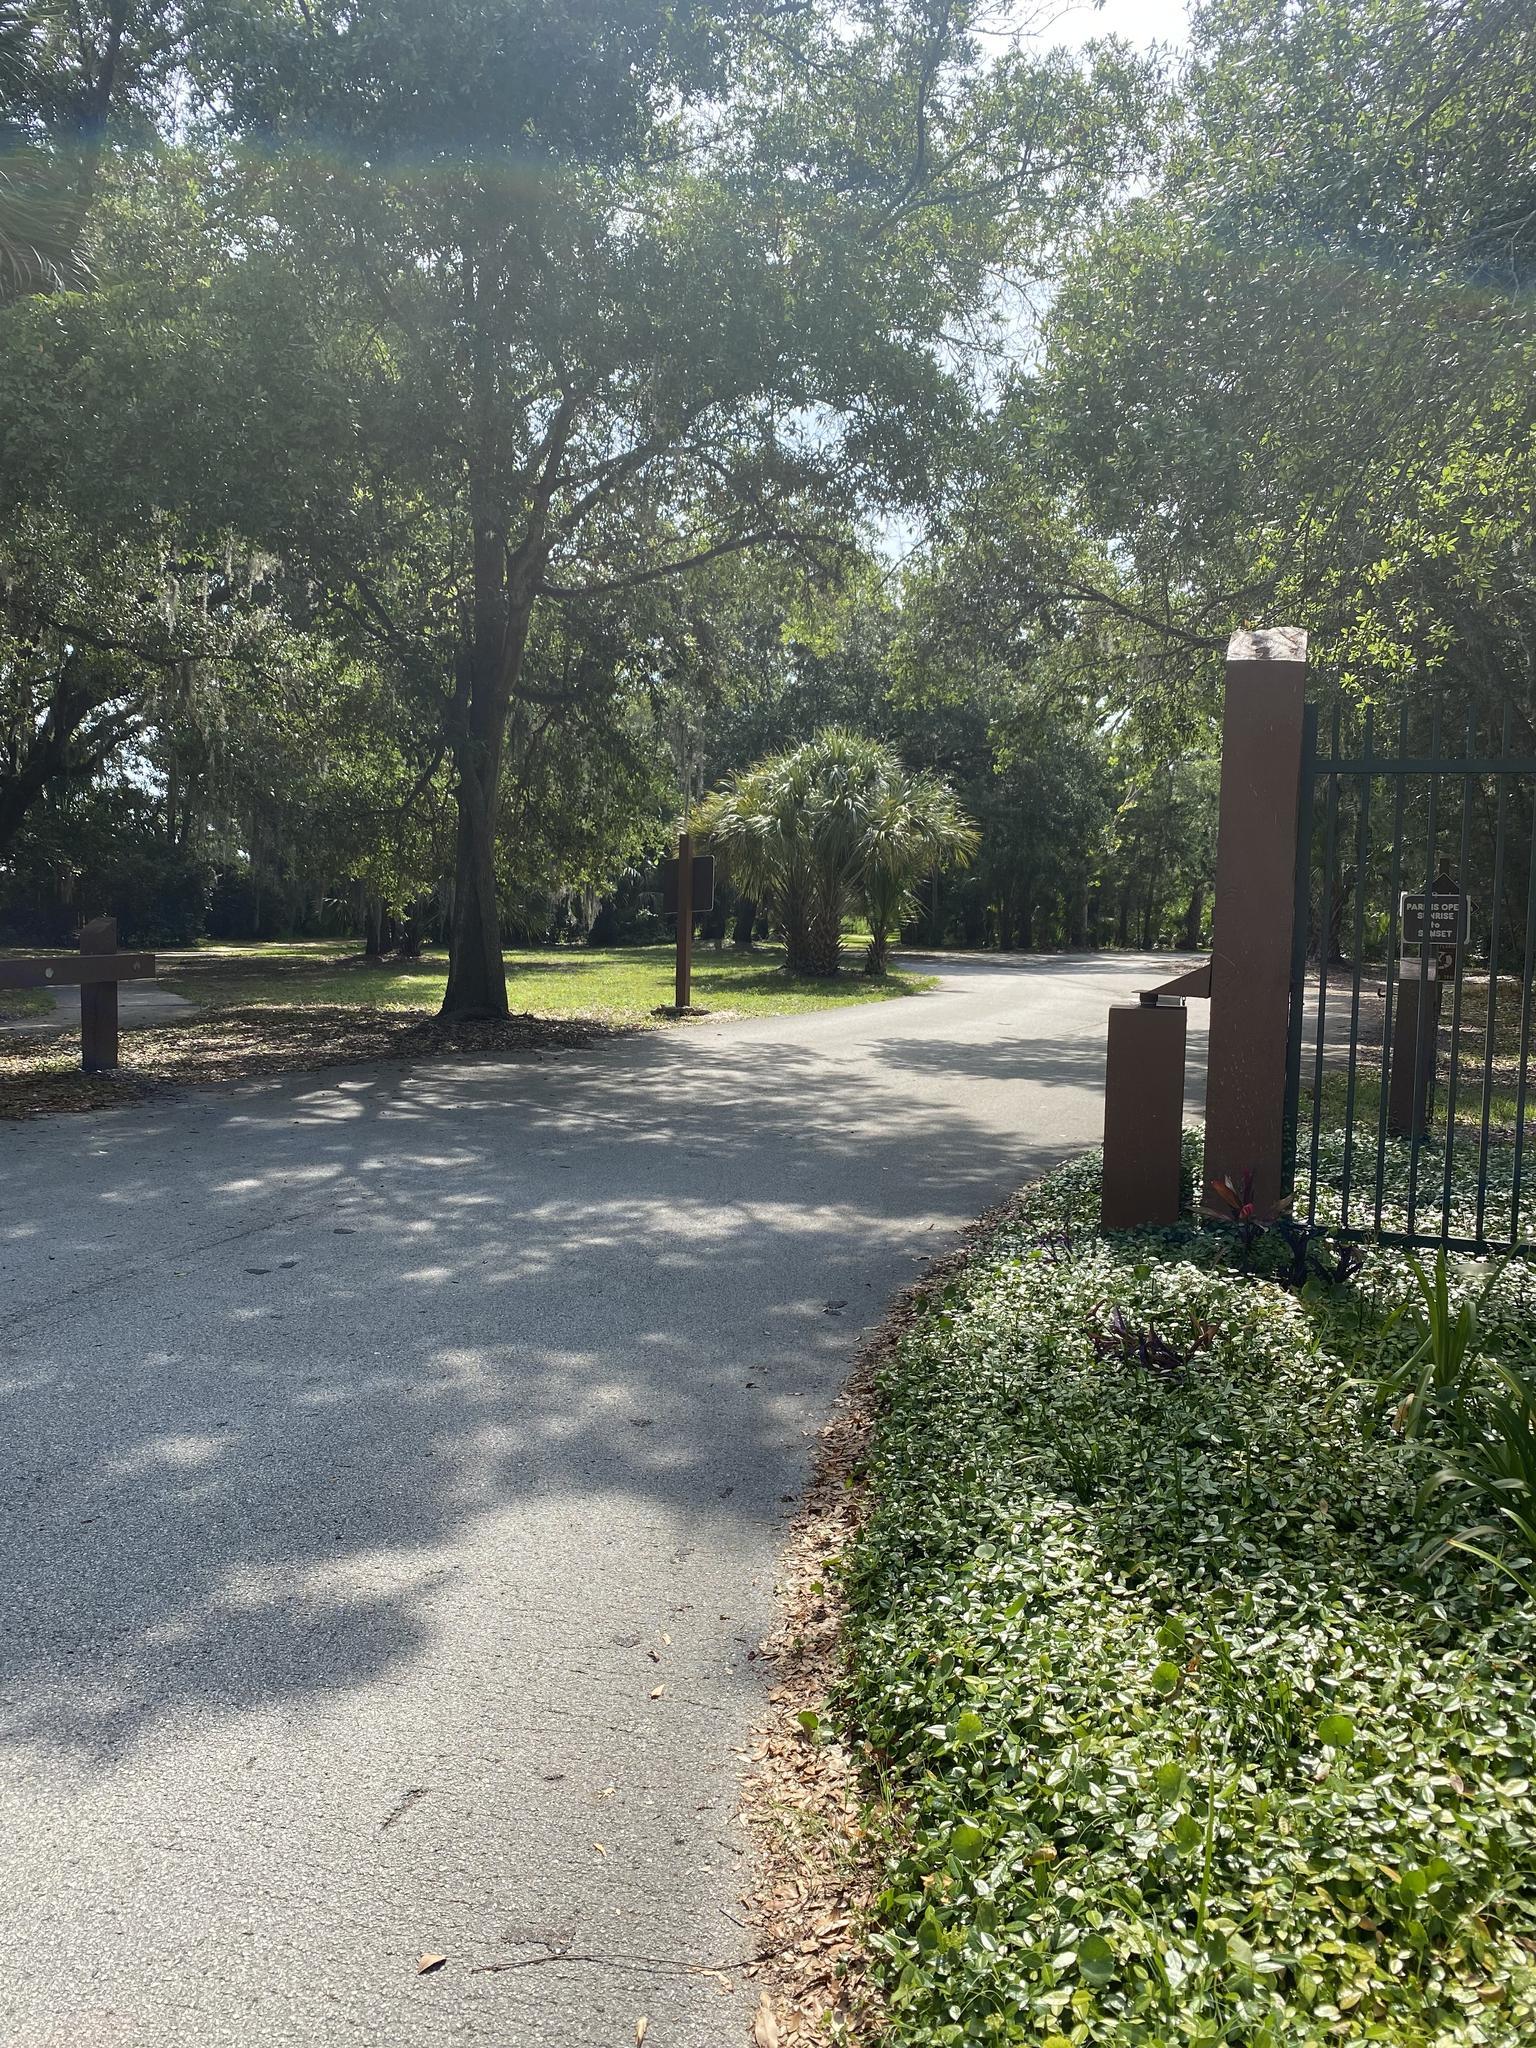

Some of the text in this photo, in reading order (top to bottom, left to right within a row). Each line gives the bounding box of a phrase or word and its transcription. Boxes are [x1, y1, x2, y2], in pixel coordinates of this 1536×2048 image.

[1406, 903, 1426, 911] PAR
[1441, 903, 1460, 911] OPE
[1417, 912, 1454, 920] SNRISE
[1417, 930, 1453, 938] SNSET
